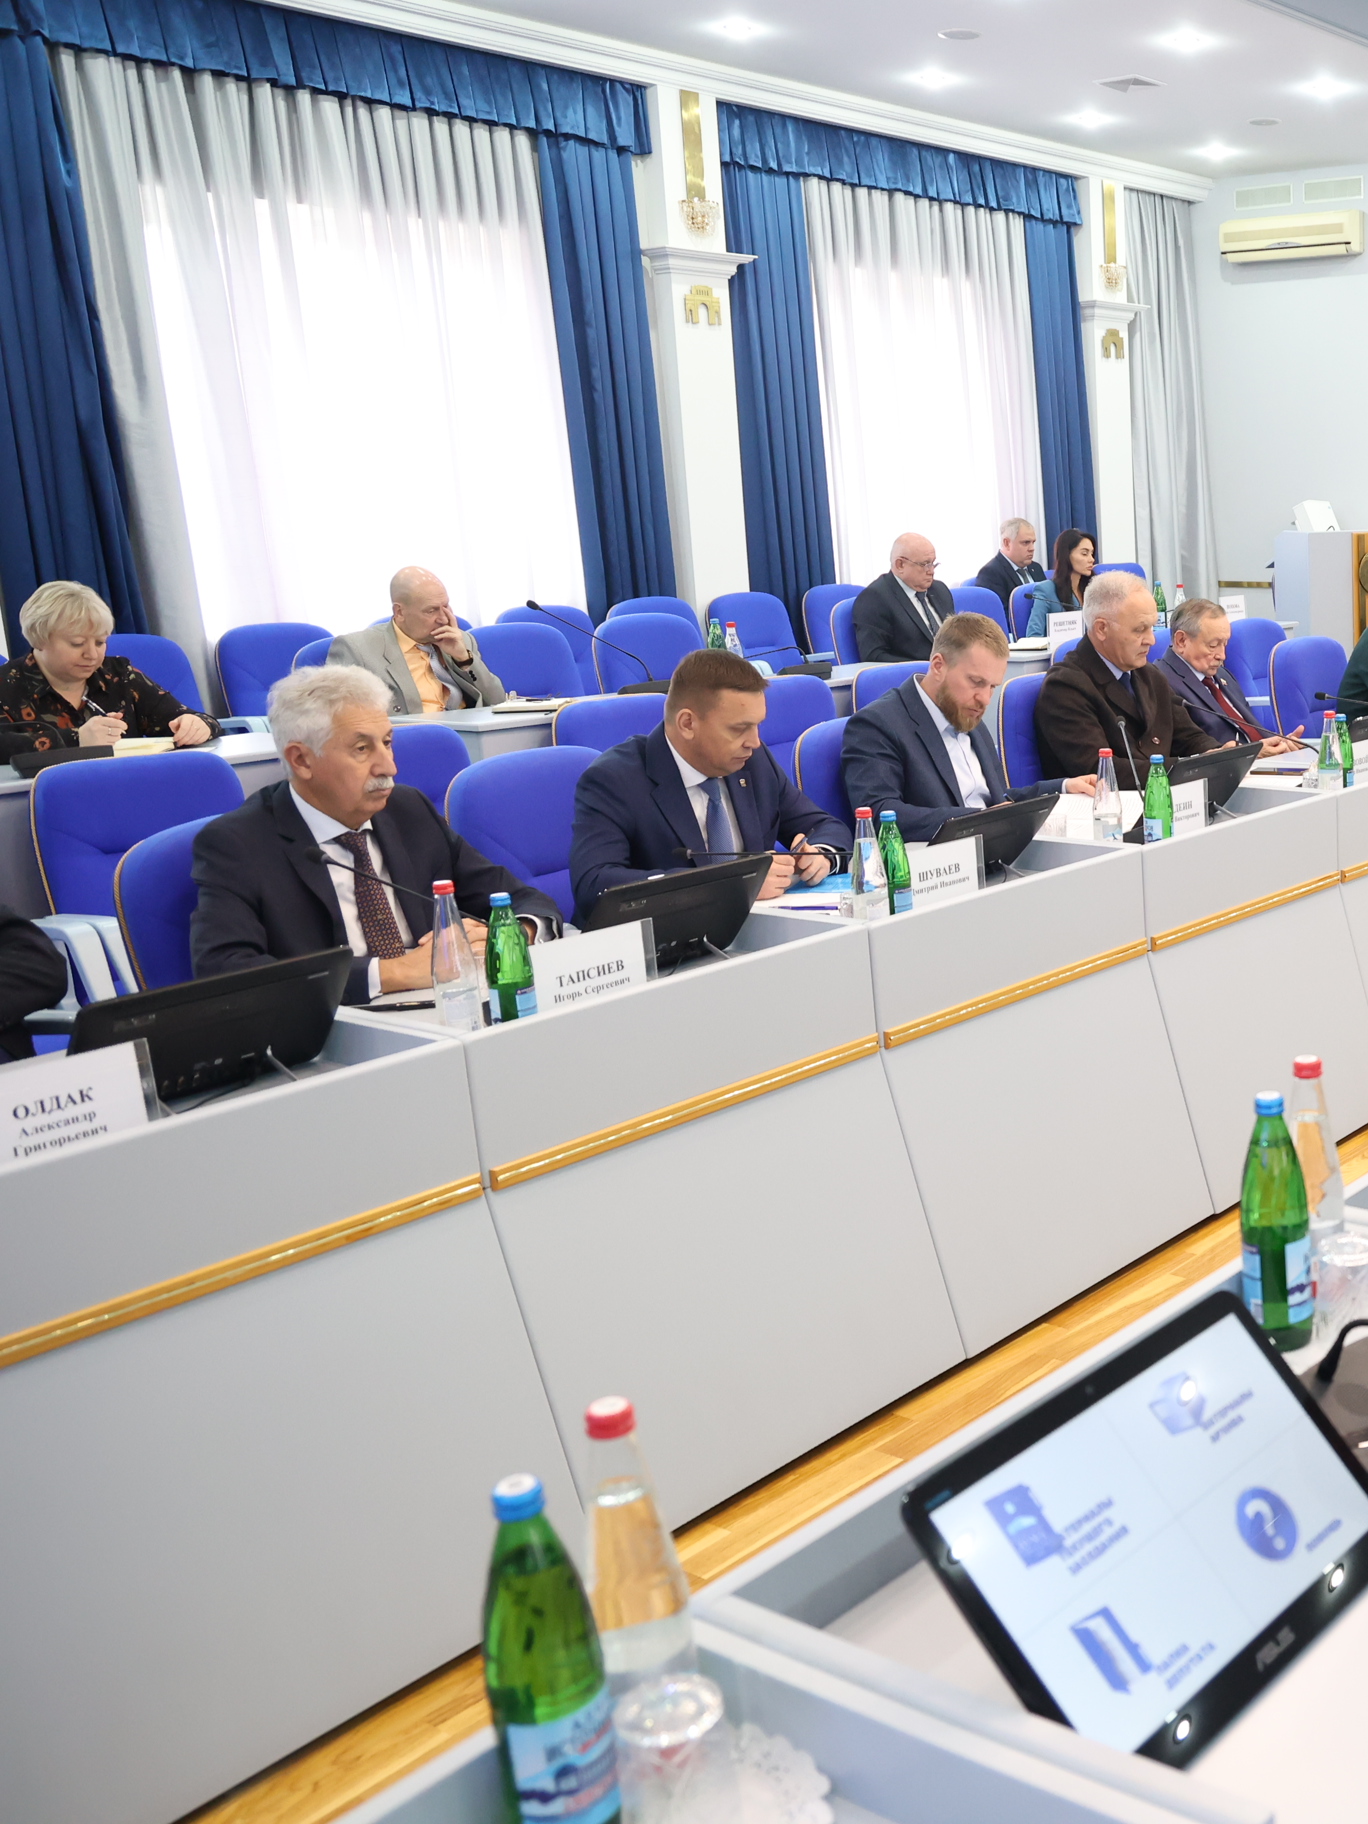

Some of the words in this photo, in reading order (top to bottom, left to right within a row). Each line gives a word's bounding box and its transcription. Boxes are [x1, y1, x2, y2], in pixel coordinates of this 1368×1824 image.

[1174, 800, 1193, 813] ДЕИН
[918, 862, 961, 883] ШУВАЕВ
[939, 876, 970, 889] Иванович
[556, 959, 625, 988] ТАПСИЕВ
[554, 991, 583, 1004] Игорь
[584, 976, 631, 995] Сергеевич
[12, 1086, 94, 1121] ОЛДАК
[19, 1110, 97, 1139] Александр
[13, 1125, 108, 1157] Григорьевич
[1255, 1625, 1296, 1672] ASUS
